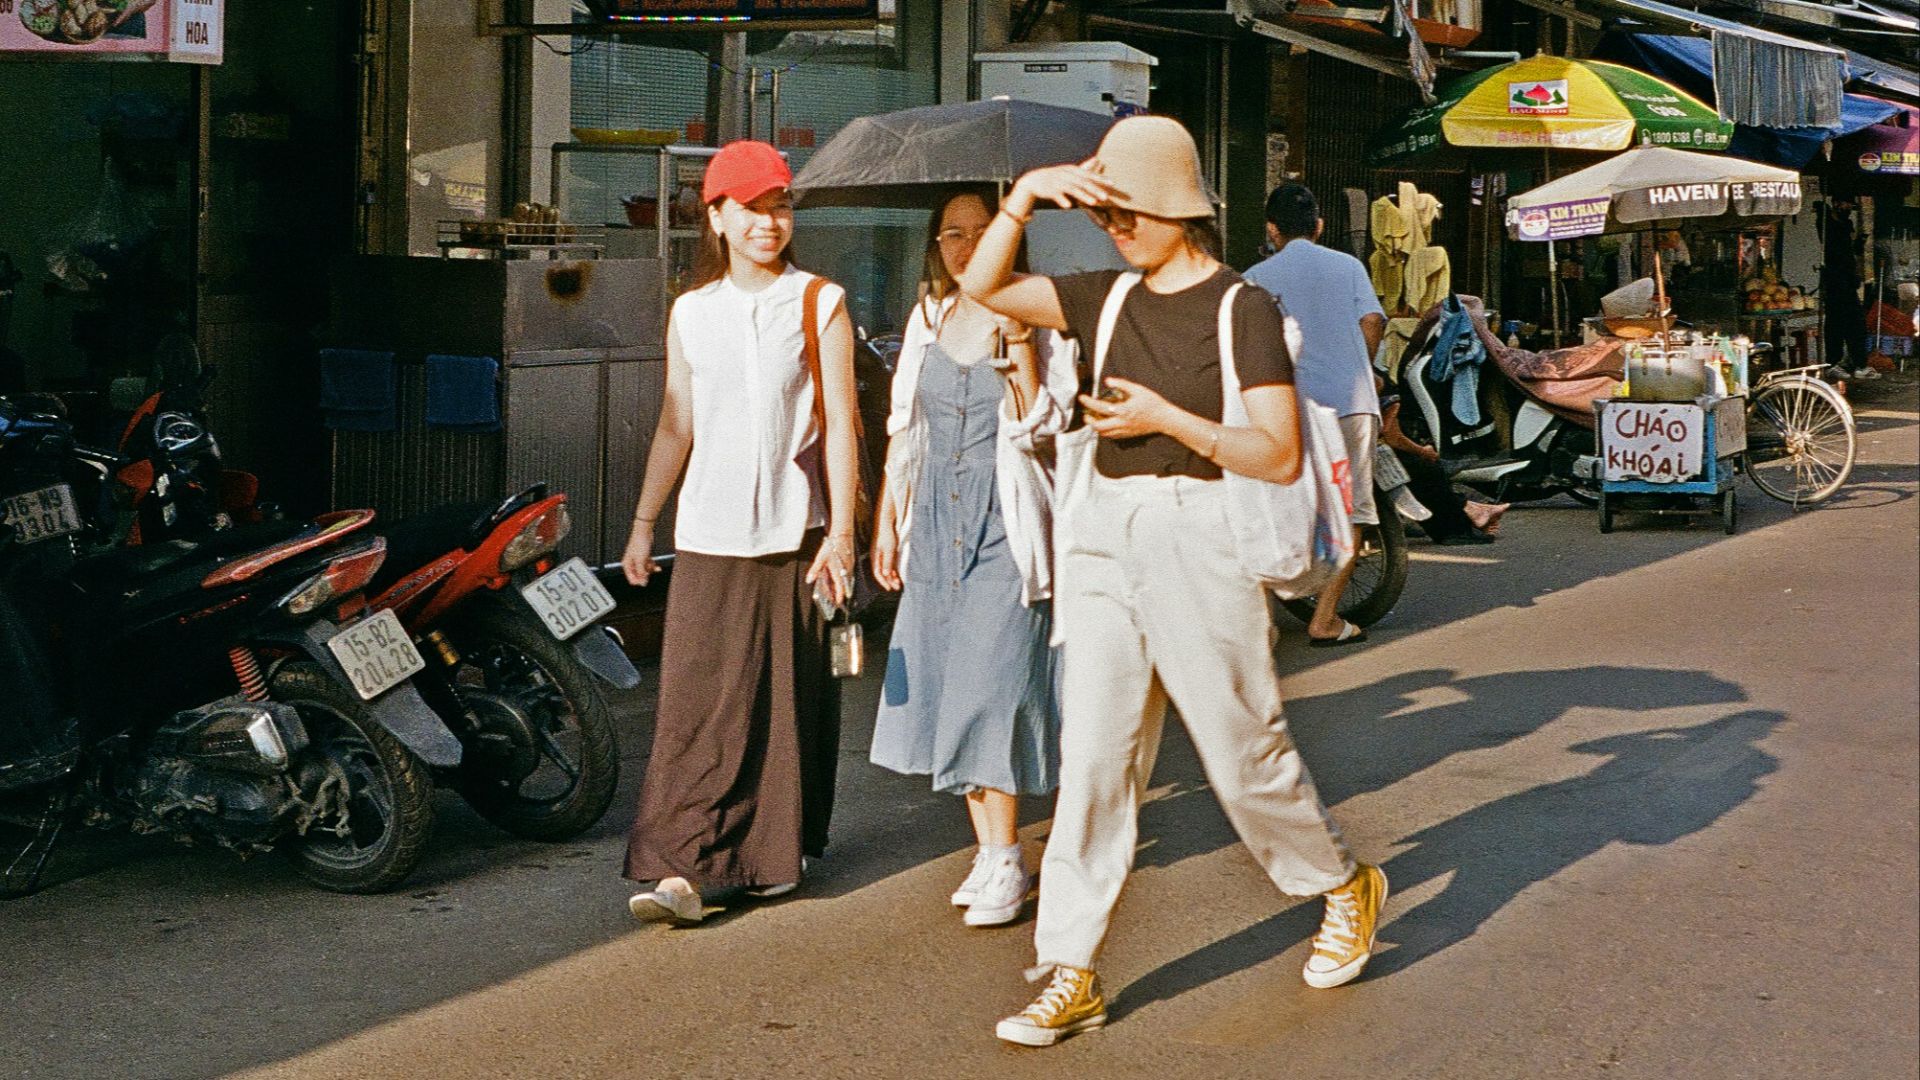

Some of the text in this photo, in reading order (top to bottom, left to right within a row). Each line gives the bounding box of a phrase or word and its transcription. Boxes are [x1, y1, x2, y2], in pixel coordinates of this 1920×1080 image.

[1649, 184, 1719, 204] HAVEN
[1549, 206, 1569, 220] KIM
[1615, 408, 1688, 443] CHÁO
[343, 619, 399, 663] 15-B2
